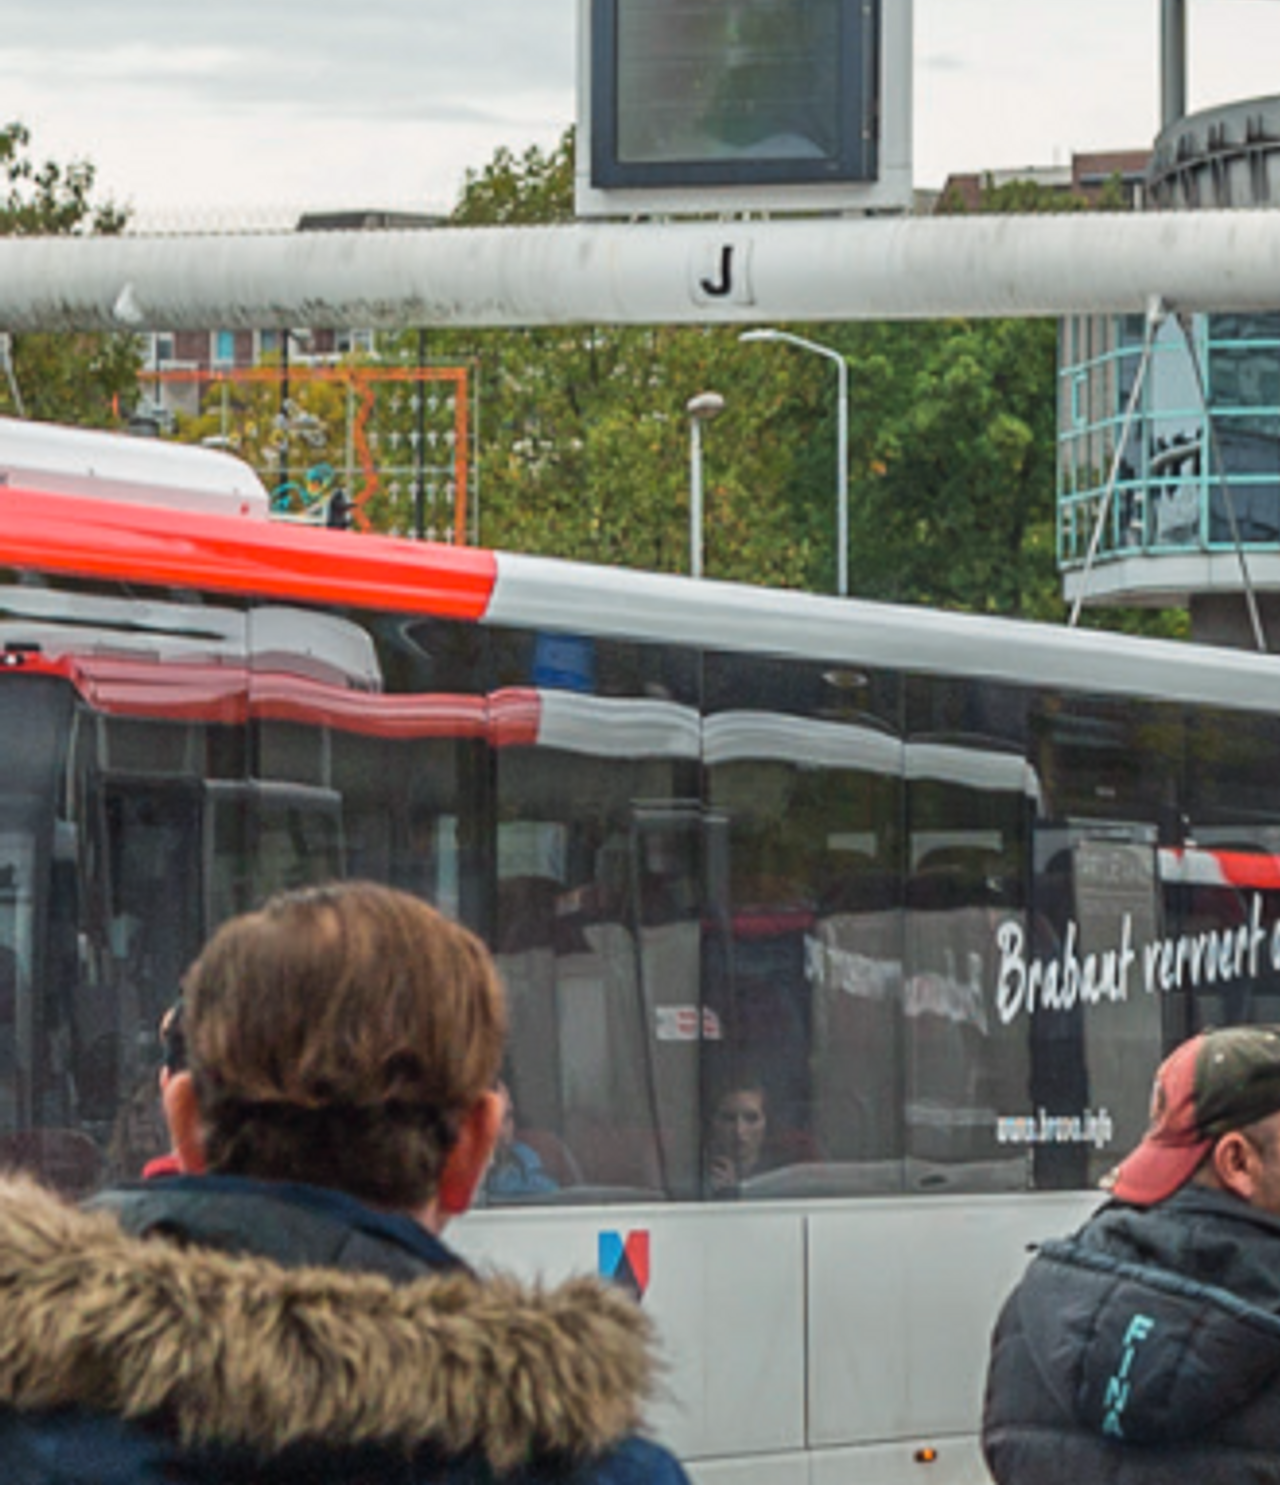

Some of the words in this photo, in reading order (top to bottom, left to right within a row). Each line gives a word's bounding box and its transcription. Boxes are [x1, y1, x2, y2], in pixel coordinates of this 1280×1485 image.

[700, 244, 733, 297] J
[996, 913, 1135, 1024] Brabant
[1143, 891, 1267, 993] vervoert
